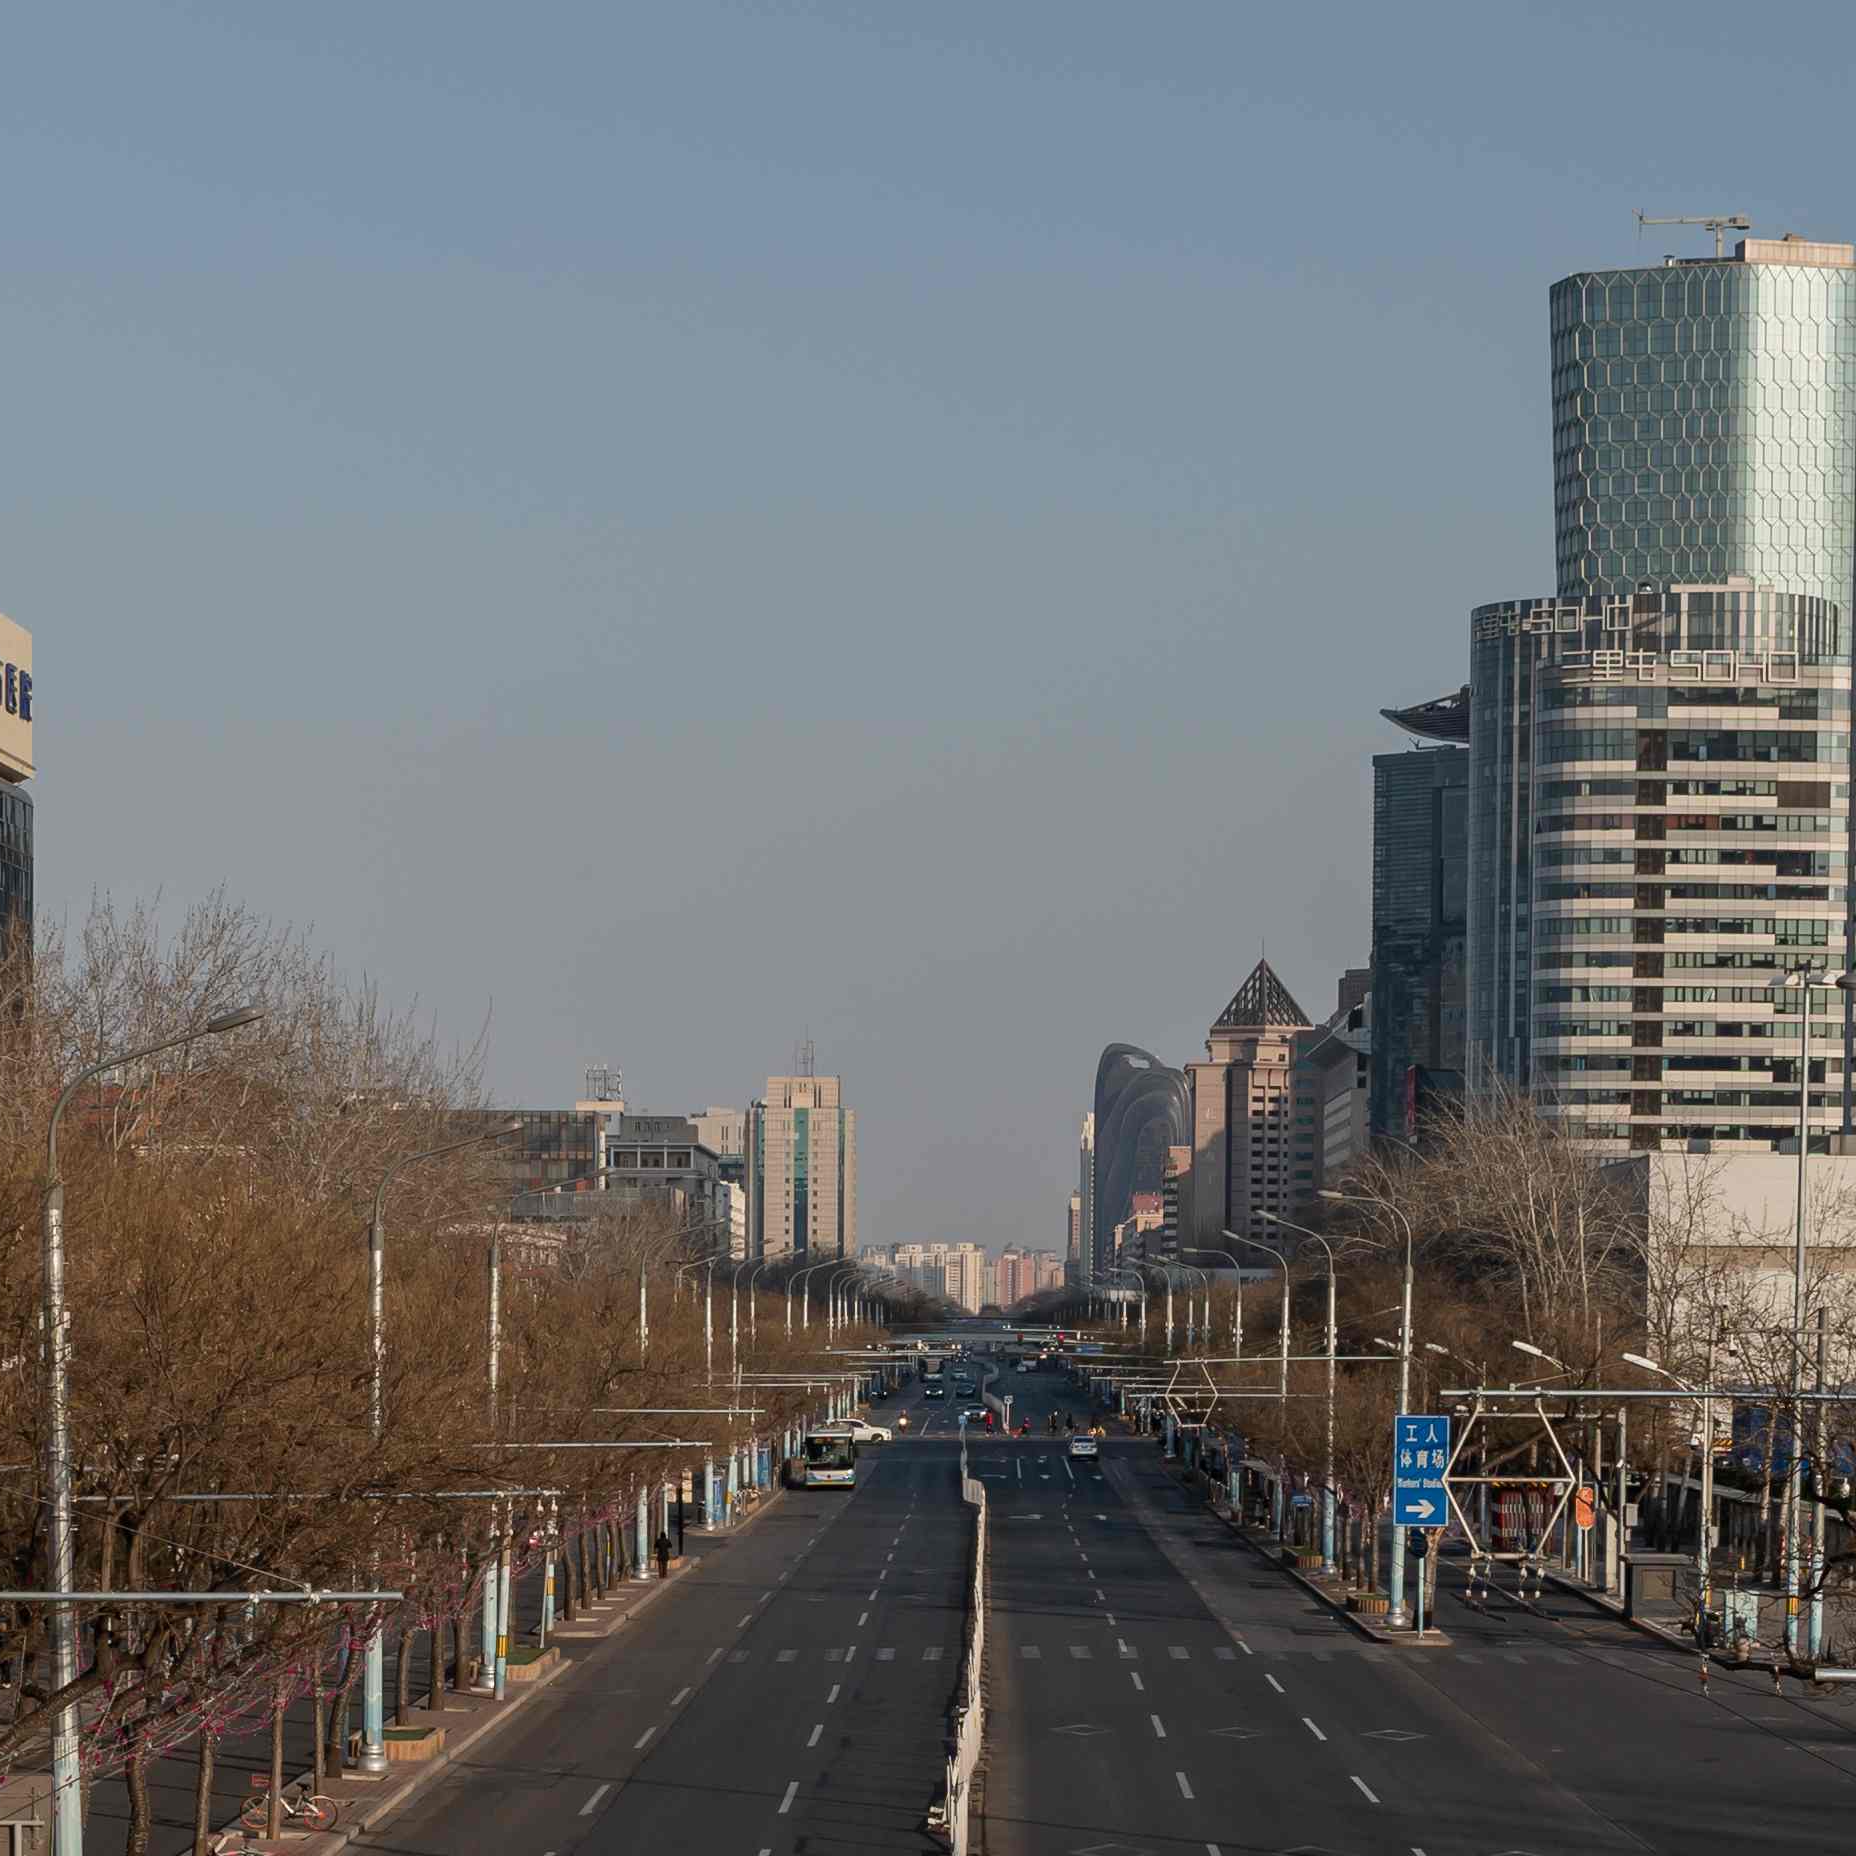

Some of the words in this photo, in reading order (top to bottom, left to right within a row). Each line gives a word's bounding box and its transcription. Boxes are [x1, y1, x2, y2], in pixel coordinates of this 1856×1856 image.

[1530, 604, 1633, 635] SOHO
[1561, 648, 1657, 683] 三里屯
[1669, 650, 1799, 683] SOHO
[1405, 1424, 1438, 1443] 工人
[1400, 1448, 1445, 1469] 体育场
